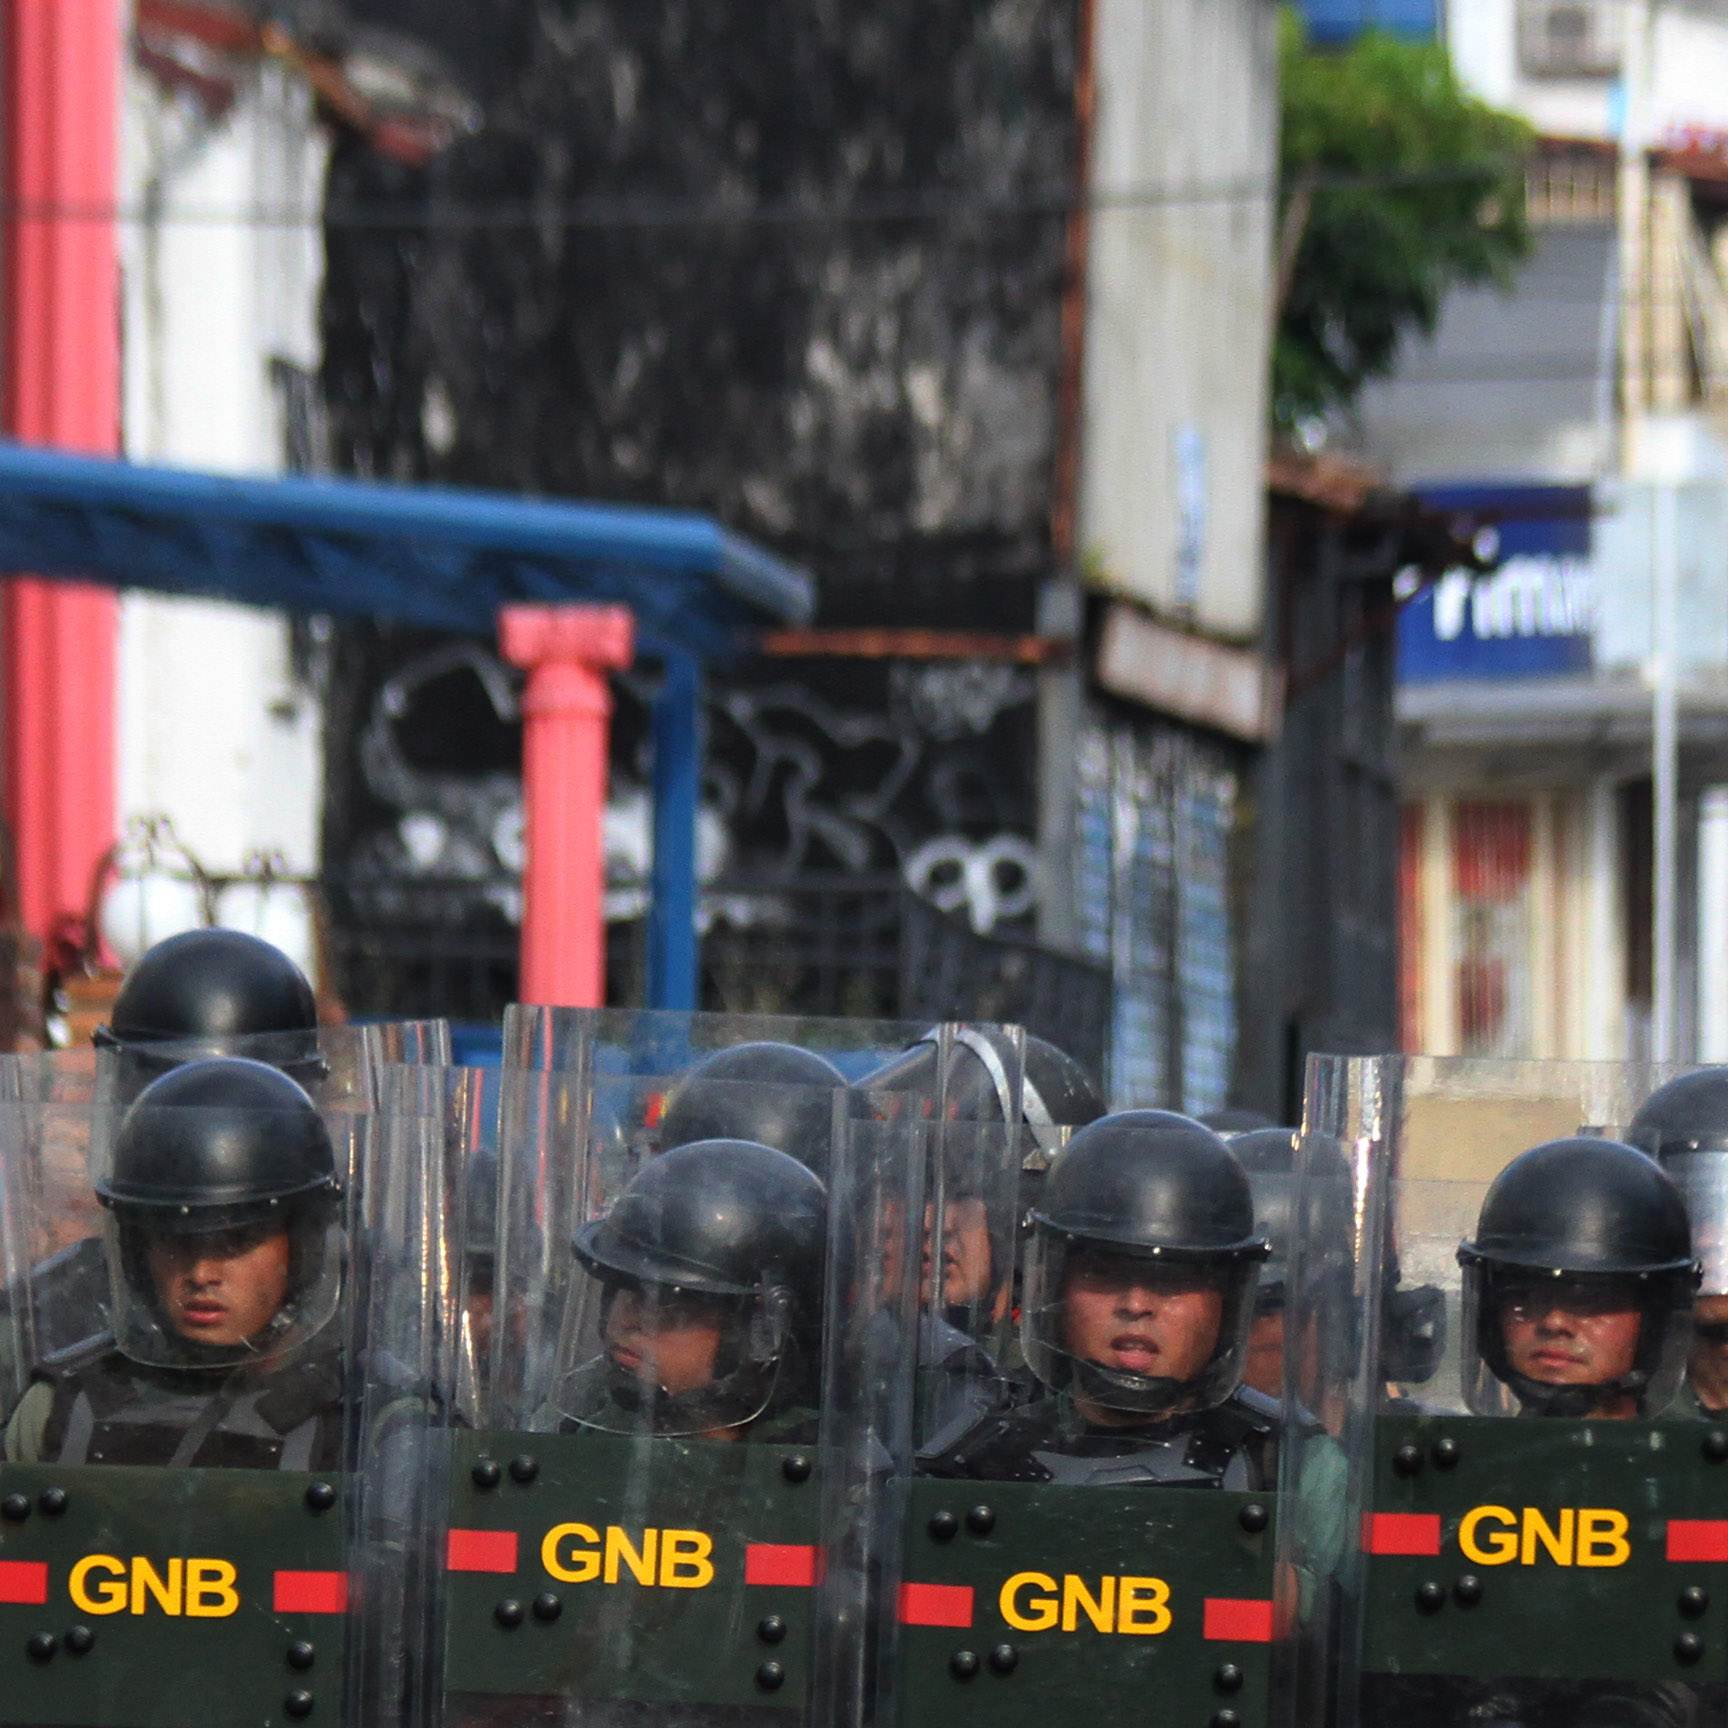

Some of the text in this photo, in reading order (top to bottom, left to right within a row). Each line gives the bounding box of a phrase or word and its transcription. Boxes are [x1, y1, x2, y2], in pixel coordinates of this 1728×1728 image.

[540, 1521, 716, 1589] GNB
[1458, 1504, 1632, 1568] GNB
[68, 1553, 241, 1618] GNB
[998, 1571, 1173, 1635] GNB
